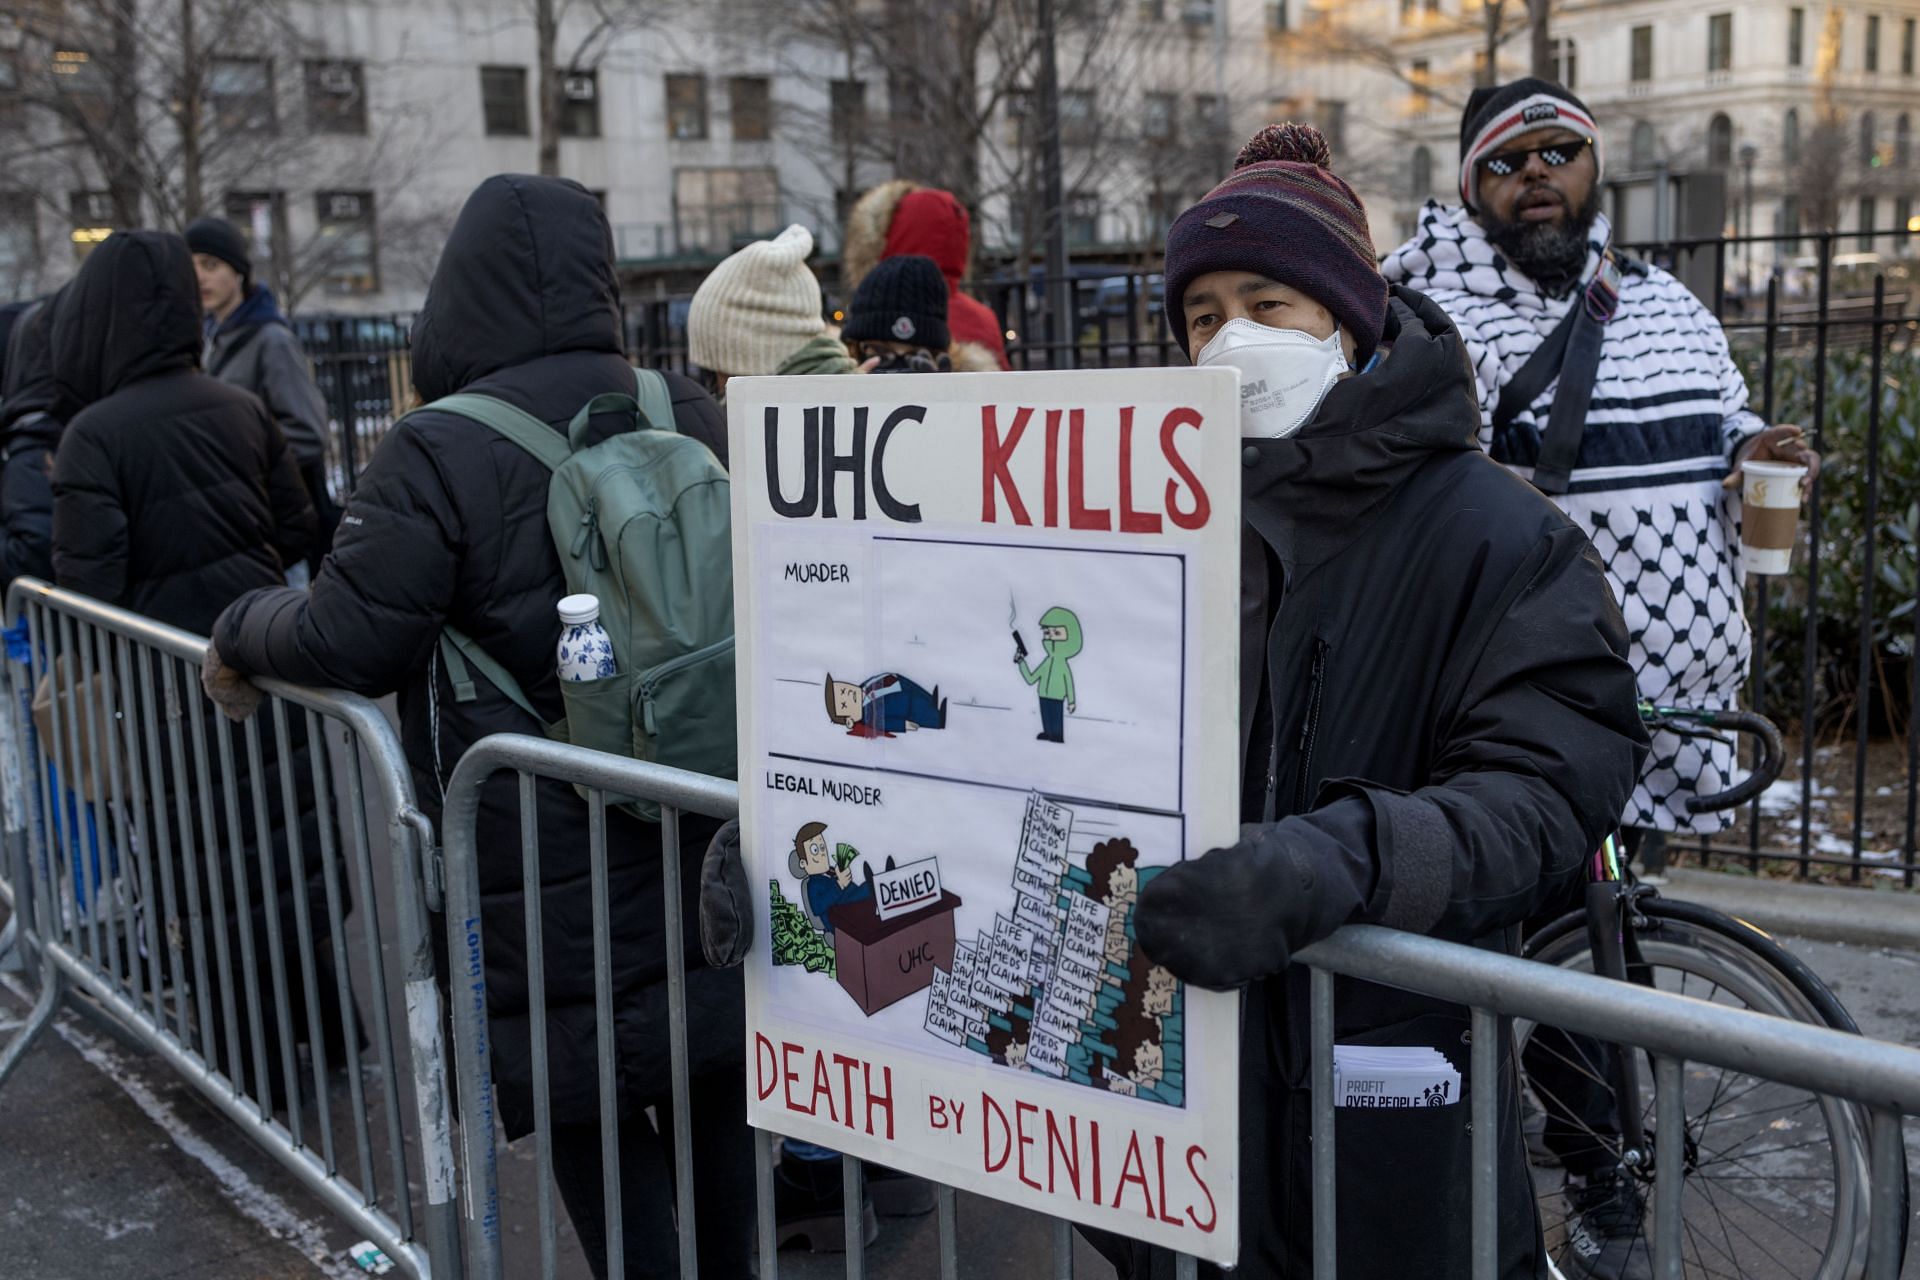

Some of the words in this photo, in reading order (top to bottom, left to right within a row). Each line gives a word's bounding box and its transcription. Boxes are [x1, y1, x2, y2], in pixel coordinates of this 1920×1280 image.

[1240, 379, 1268, 399] 3M
[764, 404, 928, 523] UHC
[981, 405, 1211, 534] KILLS
[785, 562, 850, 584] MURDER
[766, 771, 818, 796] LEGAL
[822, 778, 884, 806] MURDER
[1035, 795, 1061, 820] LIFE
[1029, 839, 1059, 866] CLAIM
[880, 870, 936, 906] DENIED
[1021, 897, 1050, 922] CLAIM
[1072, 896, 1098, 916] LIFE
[997, 921, 1023, 941] LIFE
[1068, 924, 1096, 945] MEDS
[899, 942, 935, 974] UHC
[993, 949, 1021, 970] MEDS
[1066, 938, 1096, 961] CLAIM
[990, 963, 1021, 987] CLAIM
[1062, 959, 1091, 982] CLAIM
[950, 990, 979, 1013] CLAIM
[973, 980, 1005, 1004] CLAIM
[1053, 986, 1082, 1010] CLAIM
[931, 1000, 957, 1020] MEDS
[1042, 1010, 1071, 1033] CLAIM
[929, 1013, 958, 1036] CLAIM
[1032, 1031, 1059, 1051] MEDS
[1029, 1045, 1058, 1067] CLAIM
[1346, 1080, 1386, 1093] PROFIT
[1346, 1095, 1375, 1107] OVER
[1378, 1096, 1421, 1108] PEOPLE
[755, 1031, 895, 1141] DEATH
[929, 1095, 964, 1134] BY
[982, 1091, 1217, 1233] DENIALS
